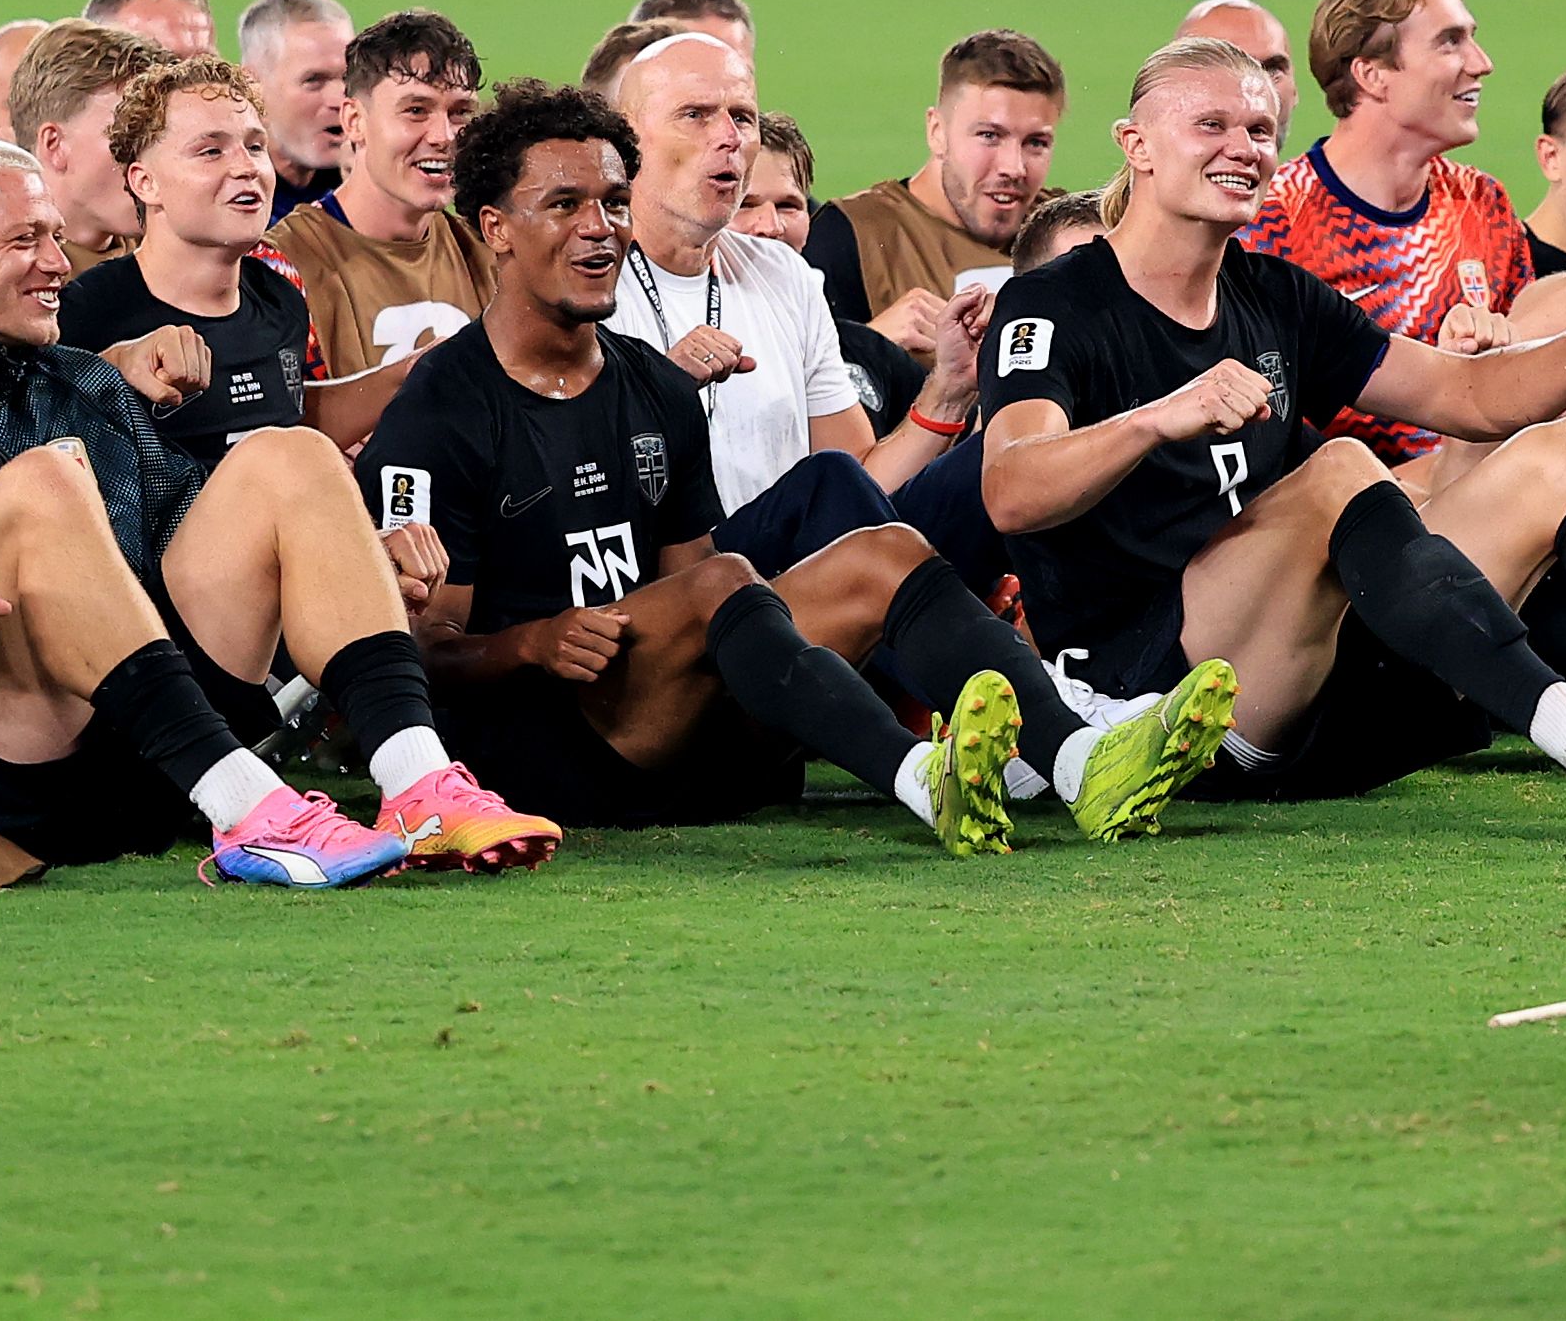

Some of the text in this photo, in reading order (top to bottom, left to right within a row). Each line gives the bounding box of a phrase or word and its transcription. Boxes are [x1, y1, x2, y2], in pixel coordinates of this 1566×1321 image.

[630, 249, 663, 311] CUP 2026
[710, 284, 720, 309] FIFA
